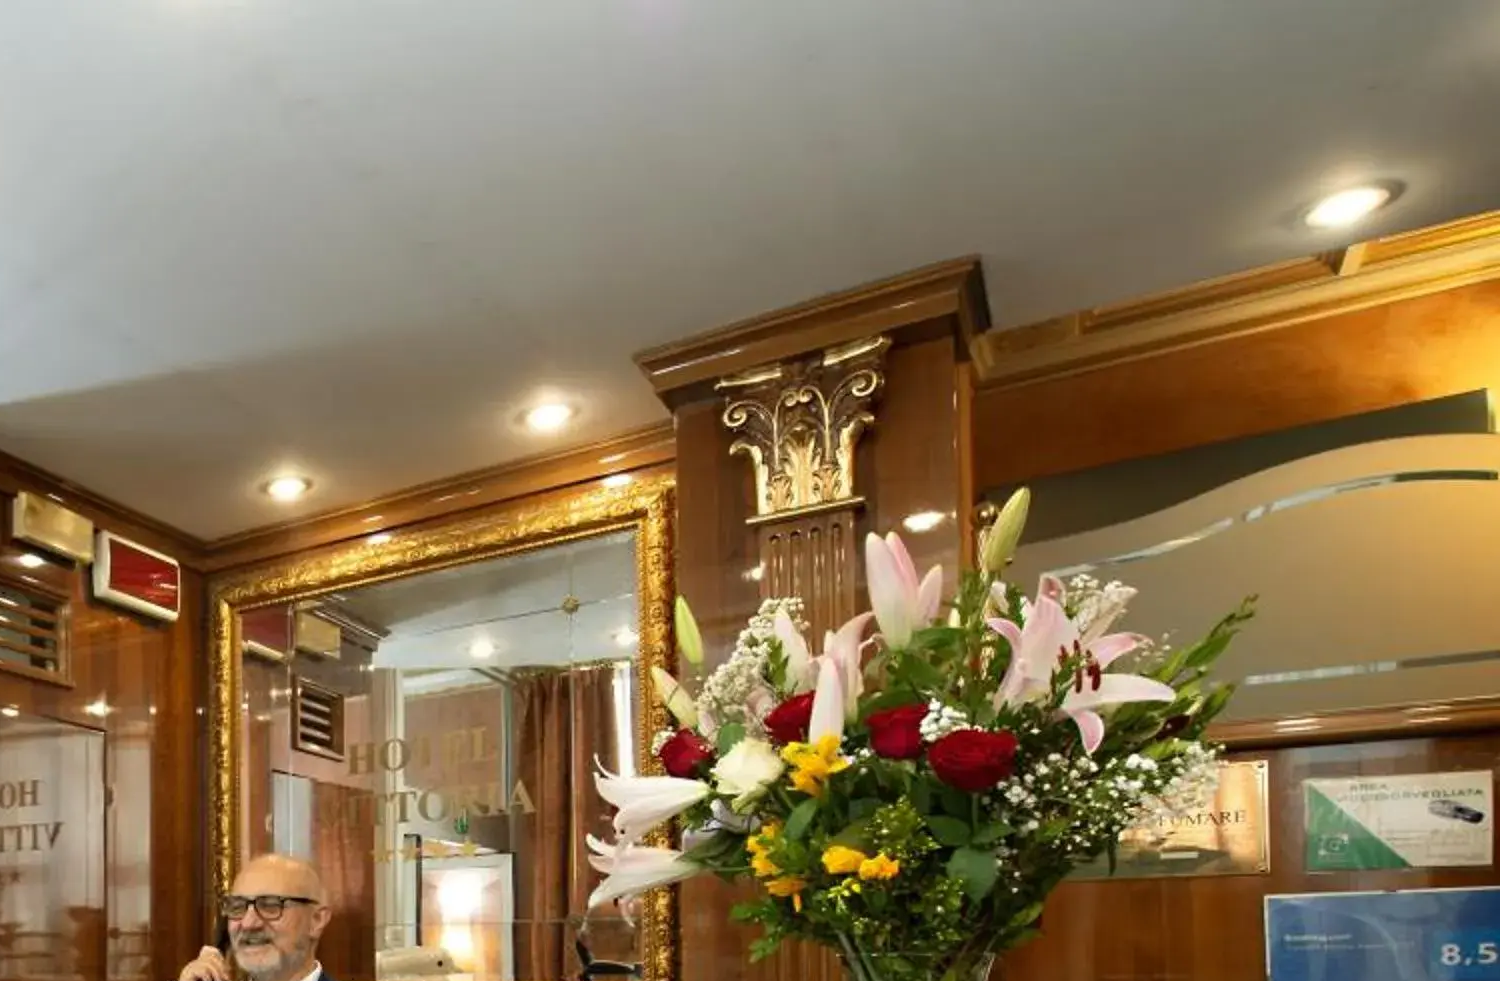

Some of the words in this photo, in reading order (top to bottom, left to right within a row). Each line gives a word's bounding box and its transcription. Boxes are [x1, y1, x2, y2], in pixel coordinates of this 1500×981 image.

[348, 727, 495, 775] HOTEL
[318, 780, 537, 829] VITTORIA
[1440, 941, 1498, 968] 8,5
